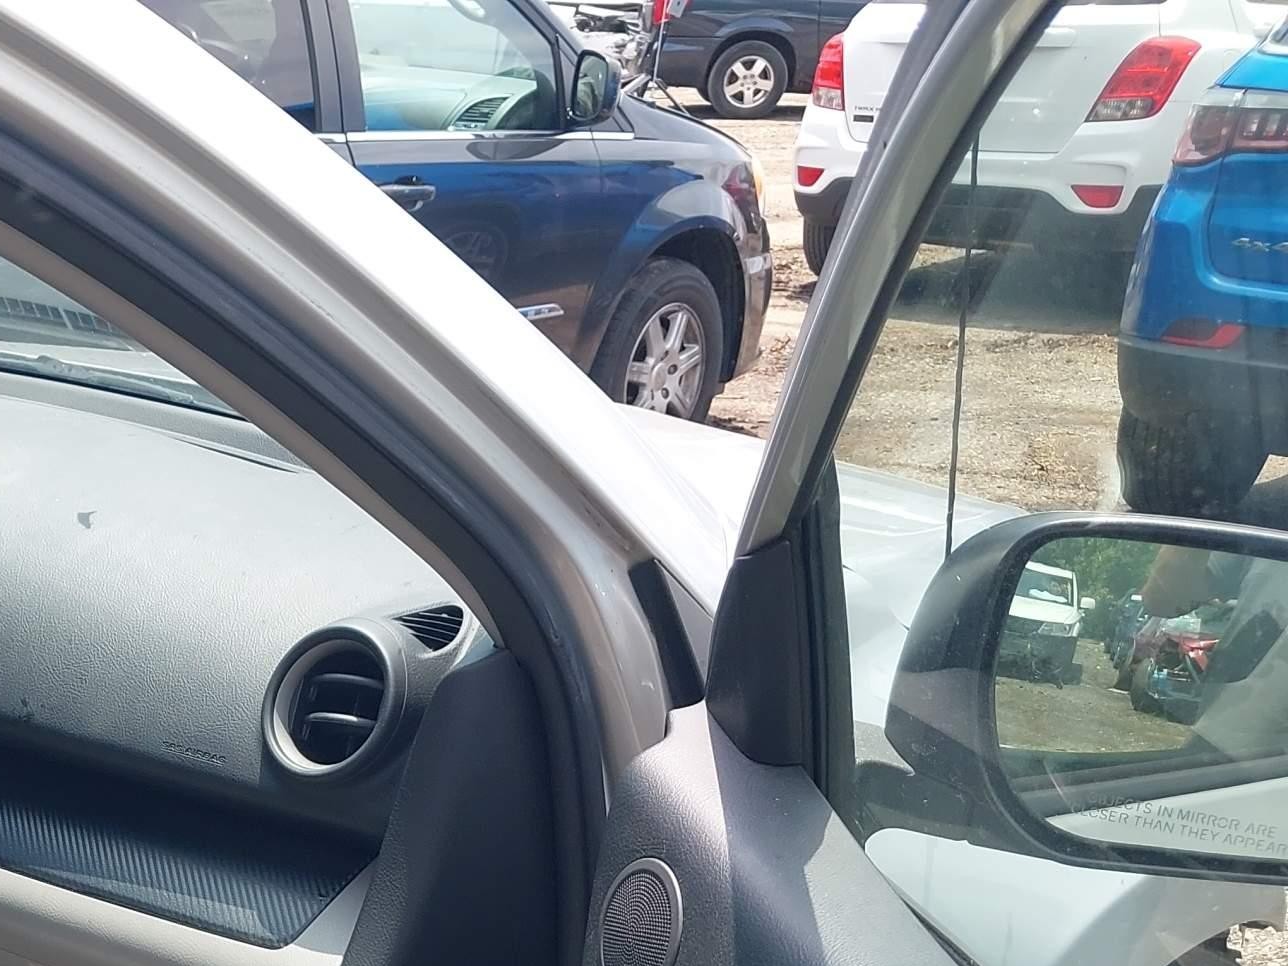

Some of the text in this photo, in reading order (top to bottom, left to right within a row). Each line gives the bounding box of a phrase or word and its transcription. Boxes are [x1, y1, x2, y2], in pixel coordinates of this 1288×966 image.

[161, 740, 227, 765] SRS AIRBAG
[1135, 814, 1175, 834] THAN
[1179, 823, 1220, 841] THEY
[1157, 804, 1175, 818] IN
[1176, 808, 1241, 832] MIRROR
[1244, 822, 1278, 840] ARE
